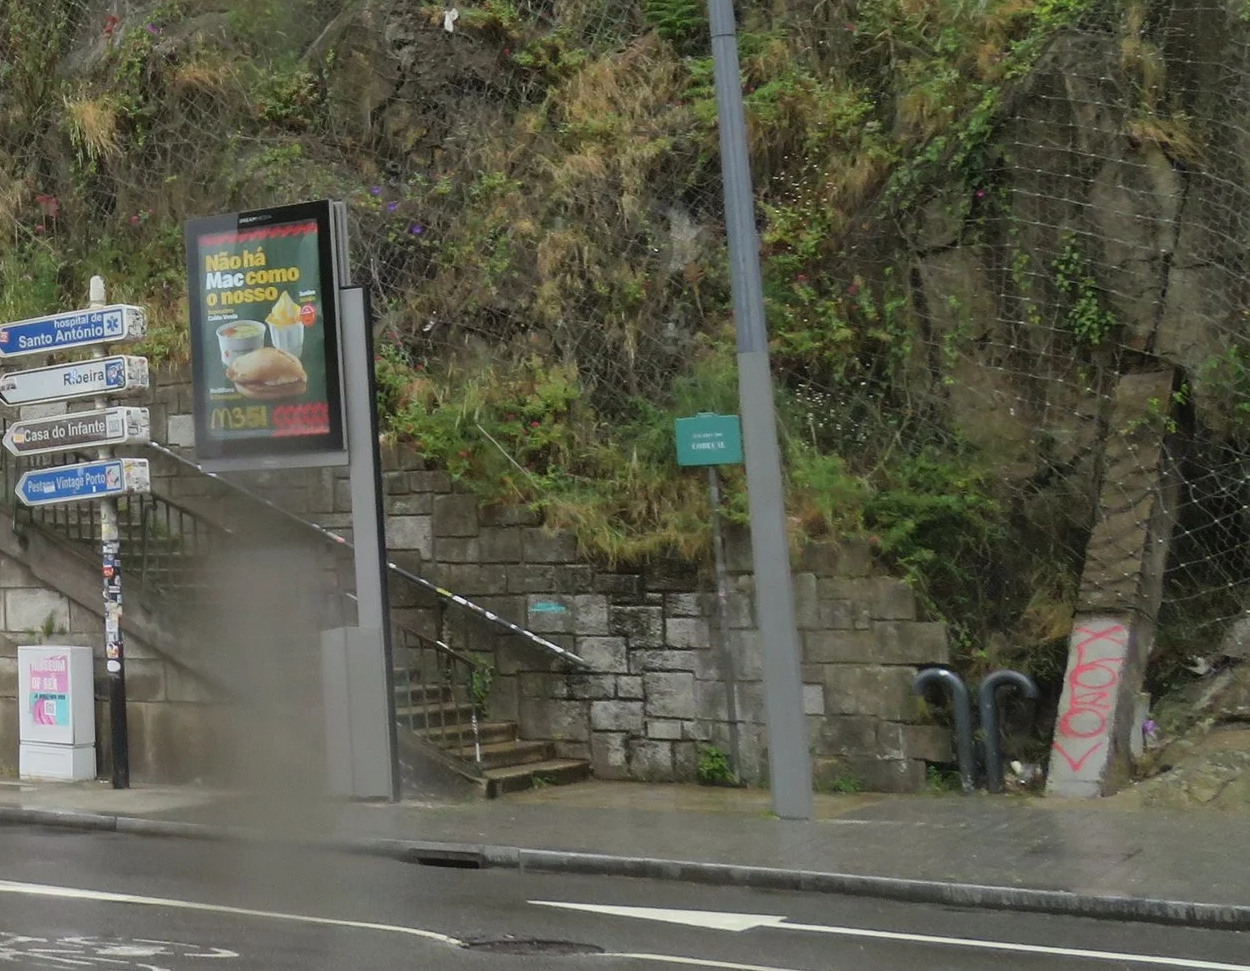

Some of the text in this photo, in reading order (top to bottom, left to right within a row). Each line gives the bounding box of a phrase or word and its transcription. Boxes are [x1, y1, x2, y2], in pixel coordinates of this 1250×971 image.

[205, 246, 266, 272] Não há
[206, 267, 300, 290] Mac como
[207, 286, 278, 307] o nosso
[54, 312, 102, 329] hospital de
[18, 325, 104, 349] Santo António
[25, 421, 105, 443] Casa do Infante
[56, 476, 84, 489] Vintage
[85, 473, 106, 485] Porto
[31, 676, 41, 689] OF
